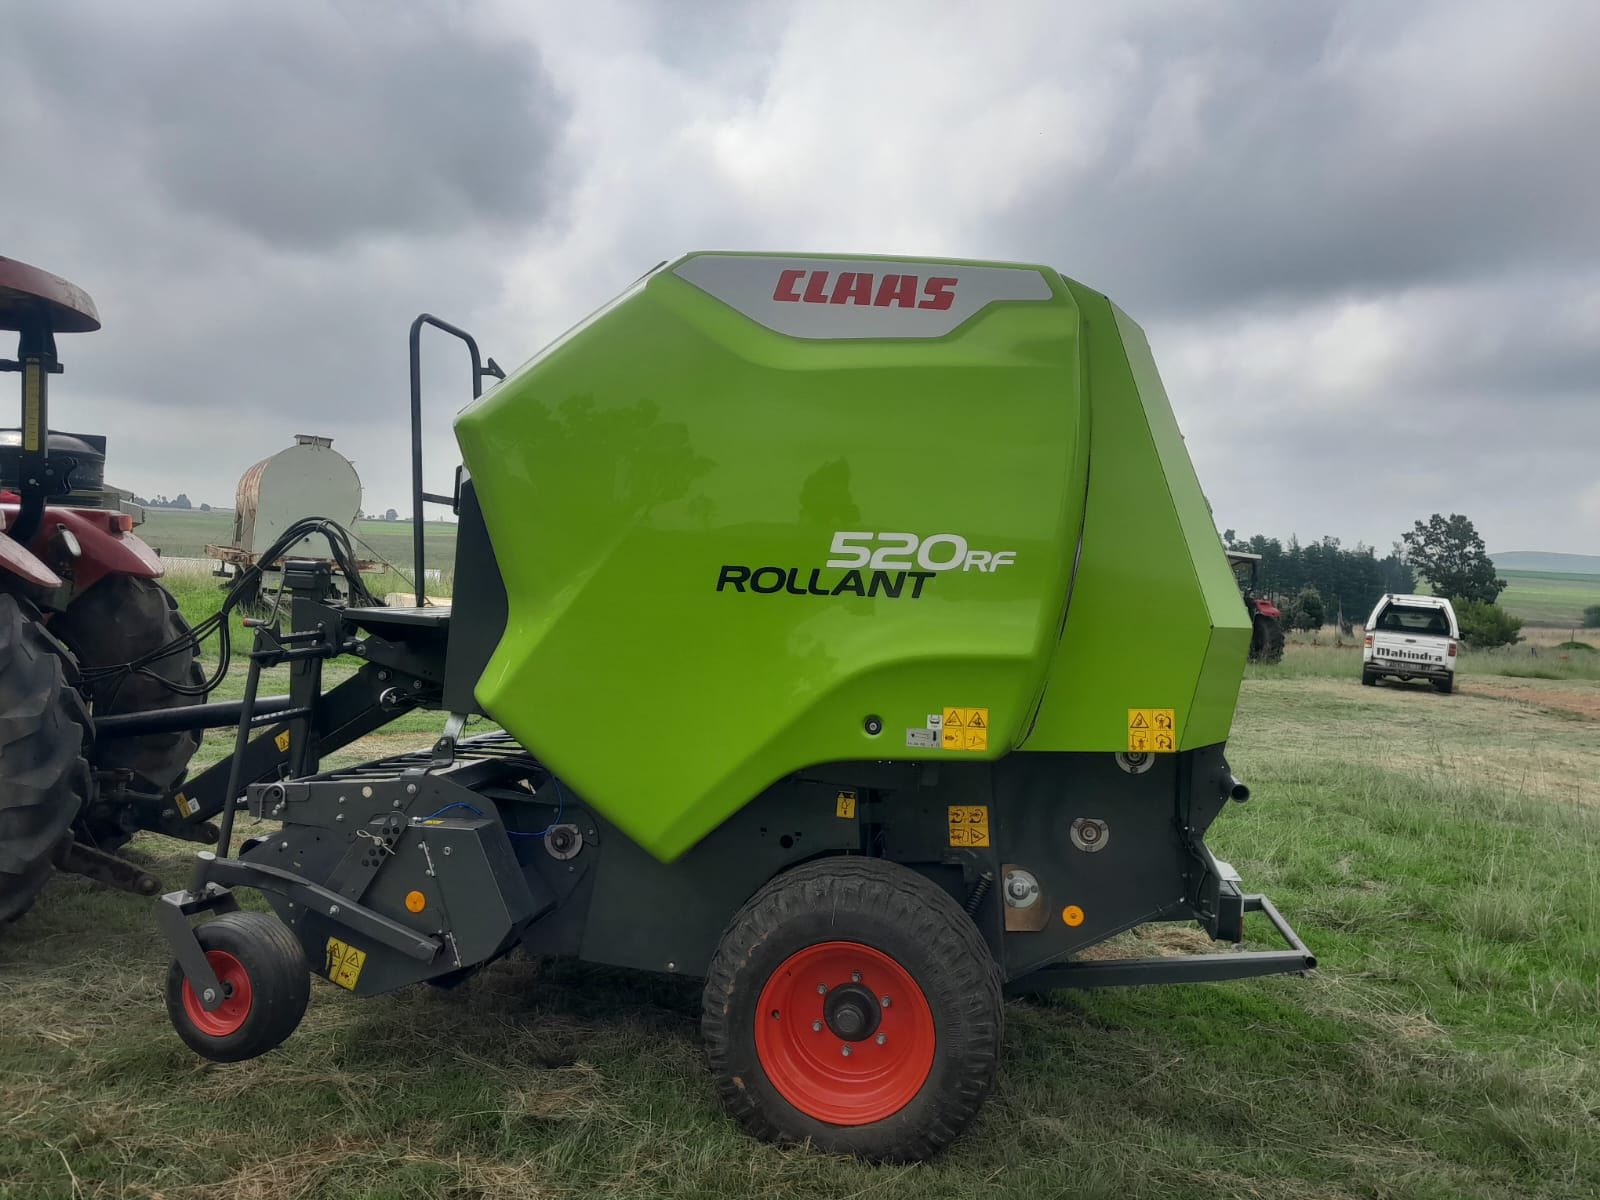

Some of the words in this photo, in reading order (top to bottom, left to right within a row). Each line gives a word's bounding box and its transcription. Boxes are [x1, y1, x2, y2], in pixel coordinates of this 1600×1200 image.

[773, 269, 959, 311] CLAAS
[716, 565, 936, 599] ROLLANT
[1376, 647, 1443, 662] Mahindra
